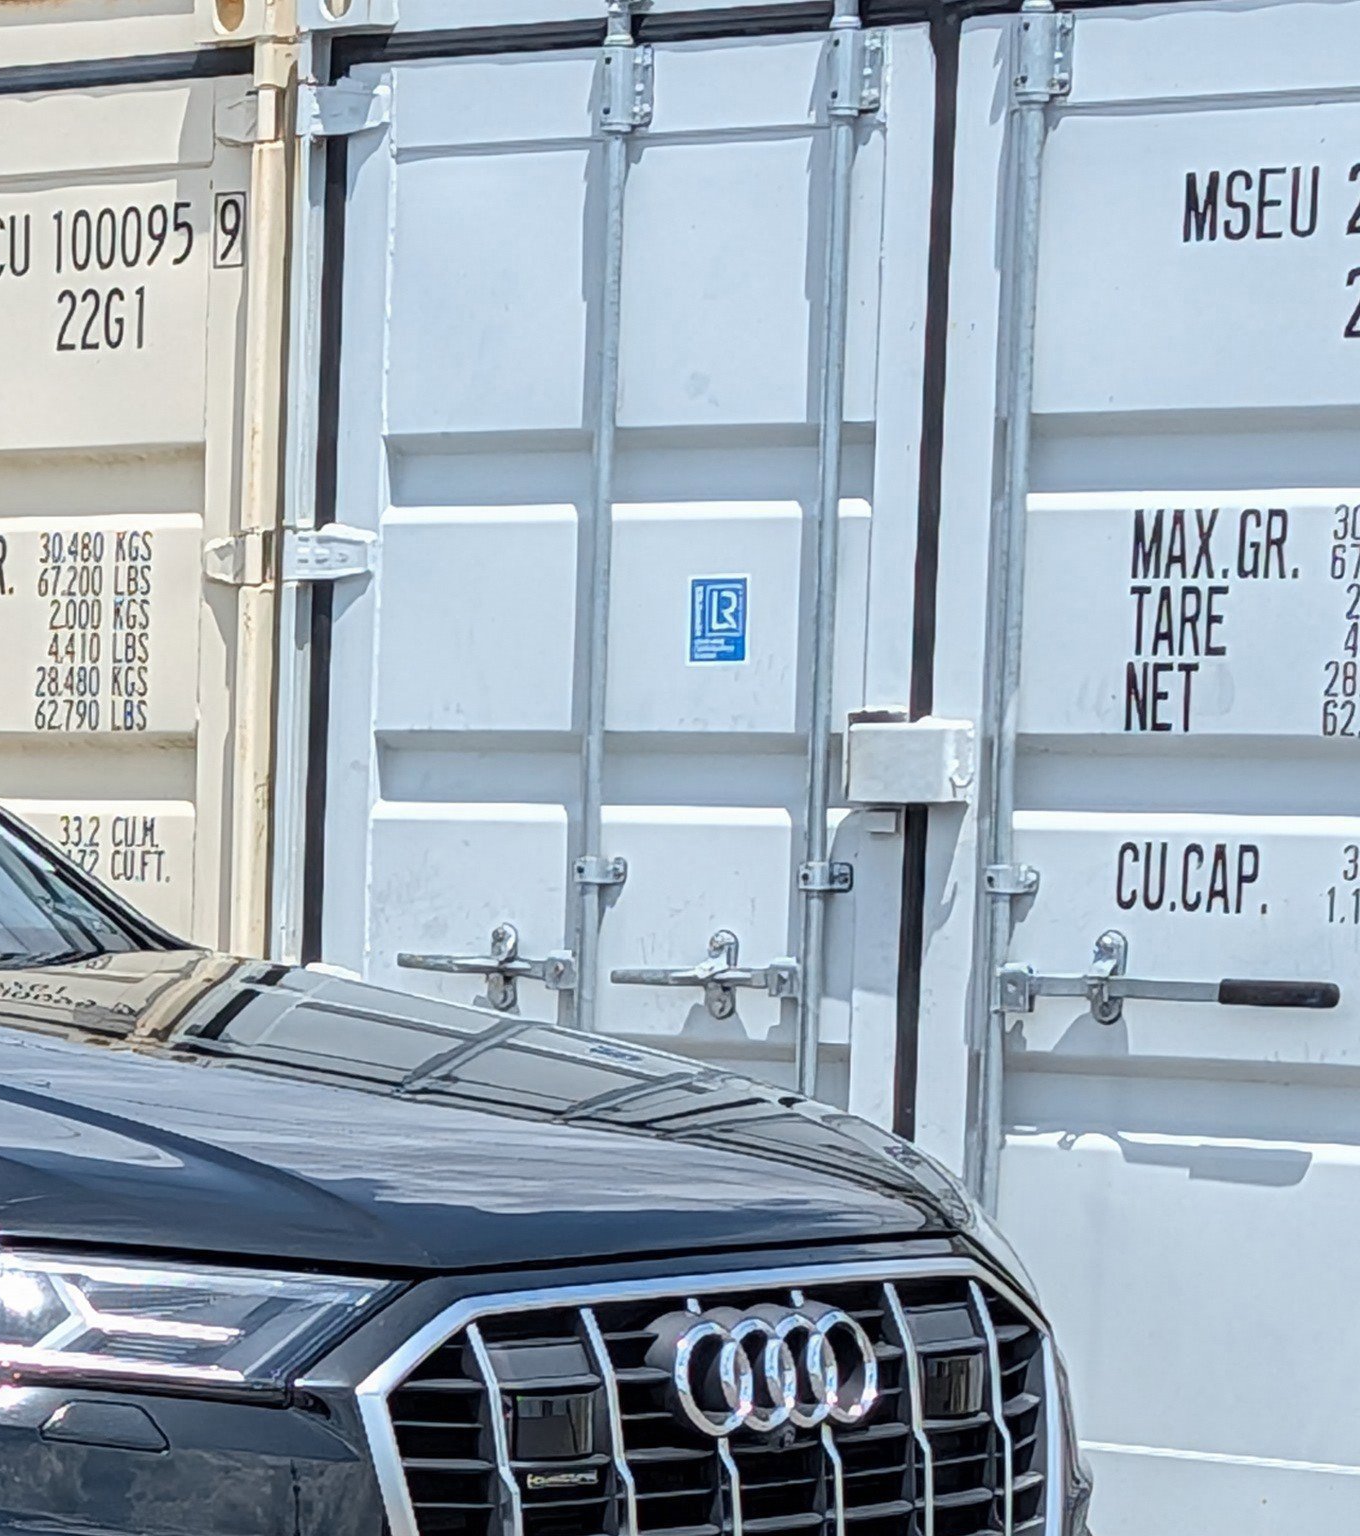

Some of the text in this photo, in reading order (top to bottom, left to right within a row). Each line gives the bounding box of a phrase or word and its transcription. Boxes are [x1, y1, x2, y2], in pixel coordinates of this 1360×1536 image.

[1182, 165, 1321, 243] MSEU
[52, 200, 194, 274] 100095
[217, 195, 244, 264] 9
[55, 285, 146, 352] 22G1
[115, 530, 154, 563] KGS
[113, 564, 152, 596] LBS
[112, 597, 150, 630] KGS
[1129, 585, 1230, 657] TARE
[112, 631, 149, 664] LBS
[111, 665, 148, 697] KGS
[1123, 660, 1360, 732] NET 28
[111, 699, 148, 731] LBS
[110, 849, 172, 883] CU.FT.
